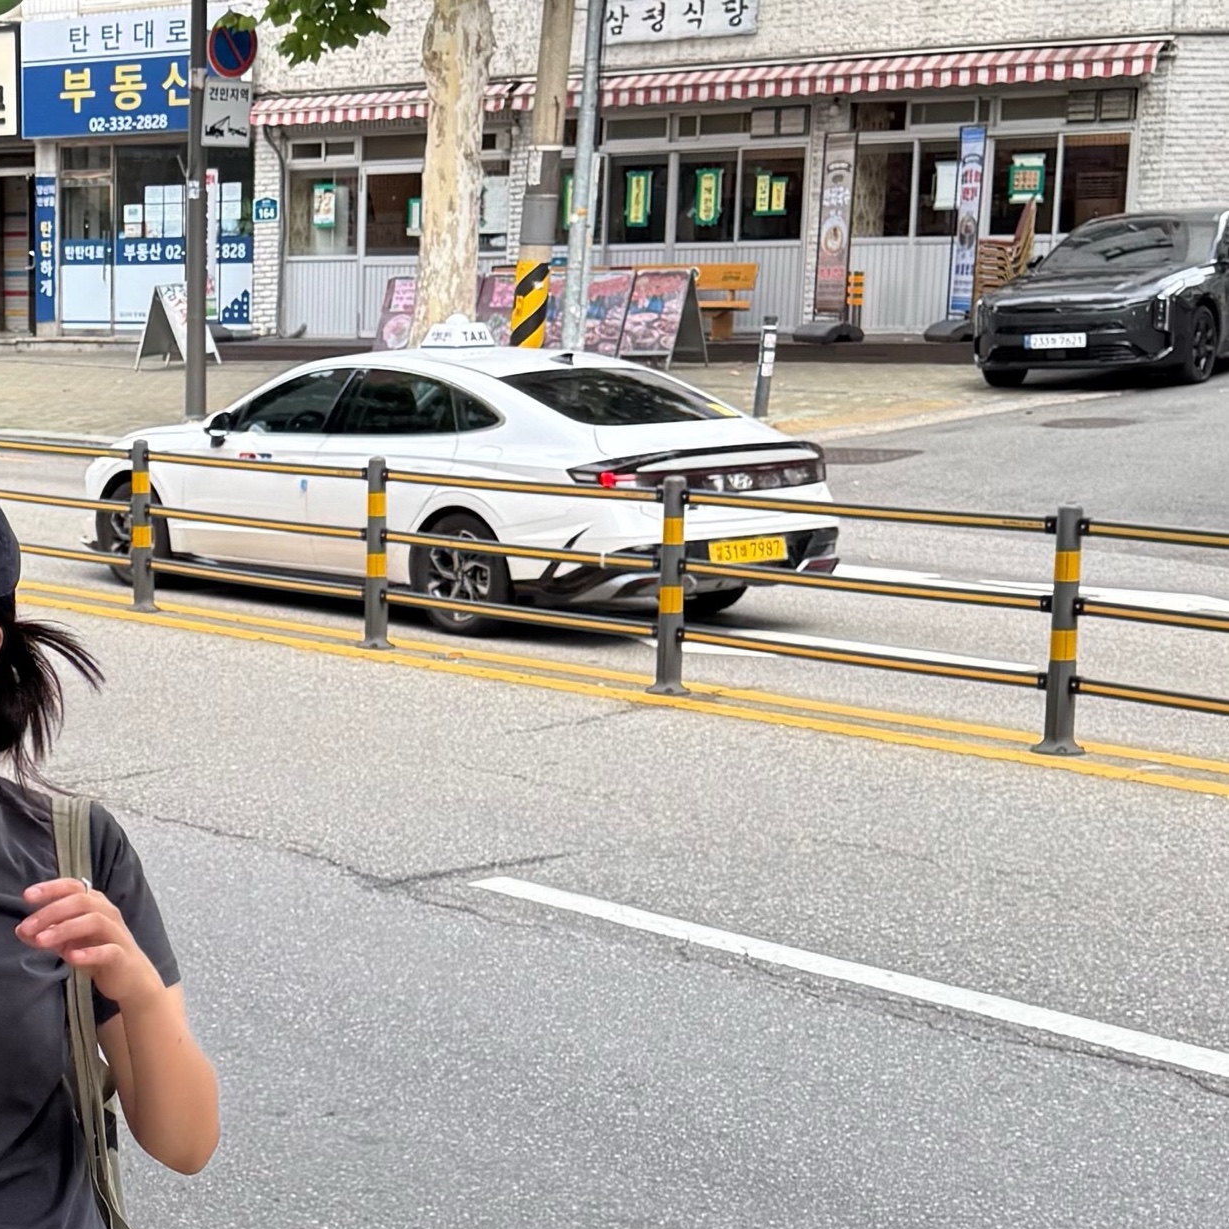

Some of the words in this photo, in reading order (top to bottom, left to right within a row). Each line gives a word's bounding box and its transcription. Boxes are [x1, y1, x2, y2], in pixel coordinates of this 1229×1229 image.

[69, 19, 189, 53] 탄탄대로
[208, 86, 250, 102] 견인지역
[88, 114, 168, 133] 02-332-2828
[258, 207, 275, 219] 164
[40, 221, 53, 297] 탄탄하게
[123, 243, 162, 262] 부동산
[461, 330, 488, 343] TAXI
